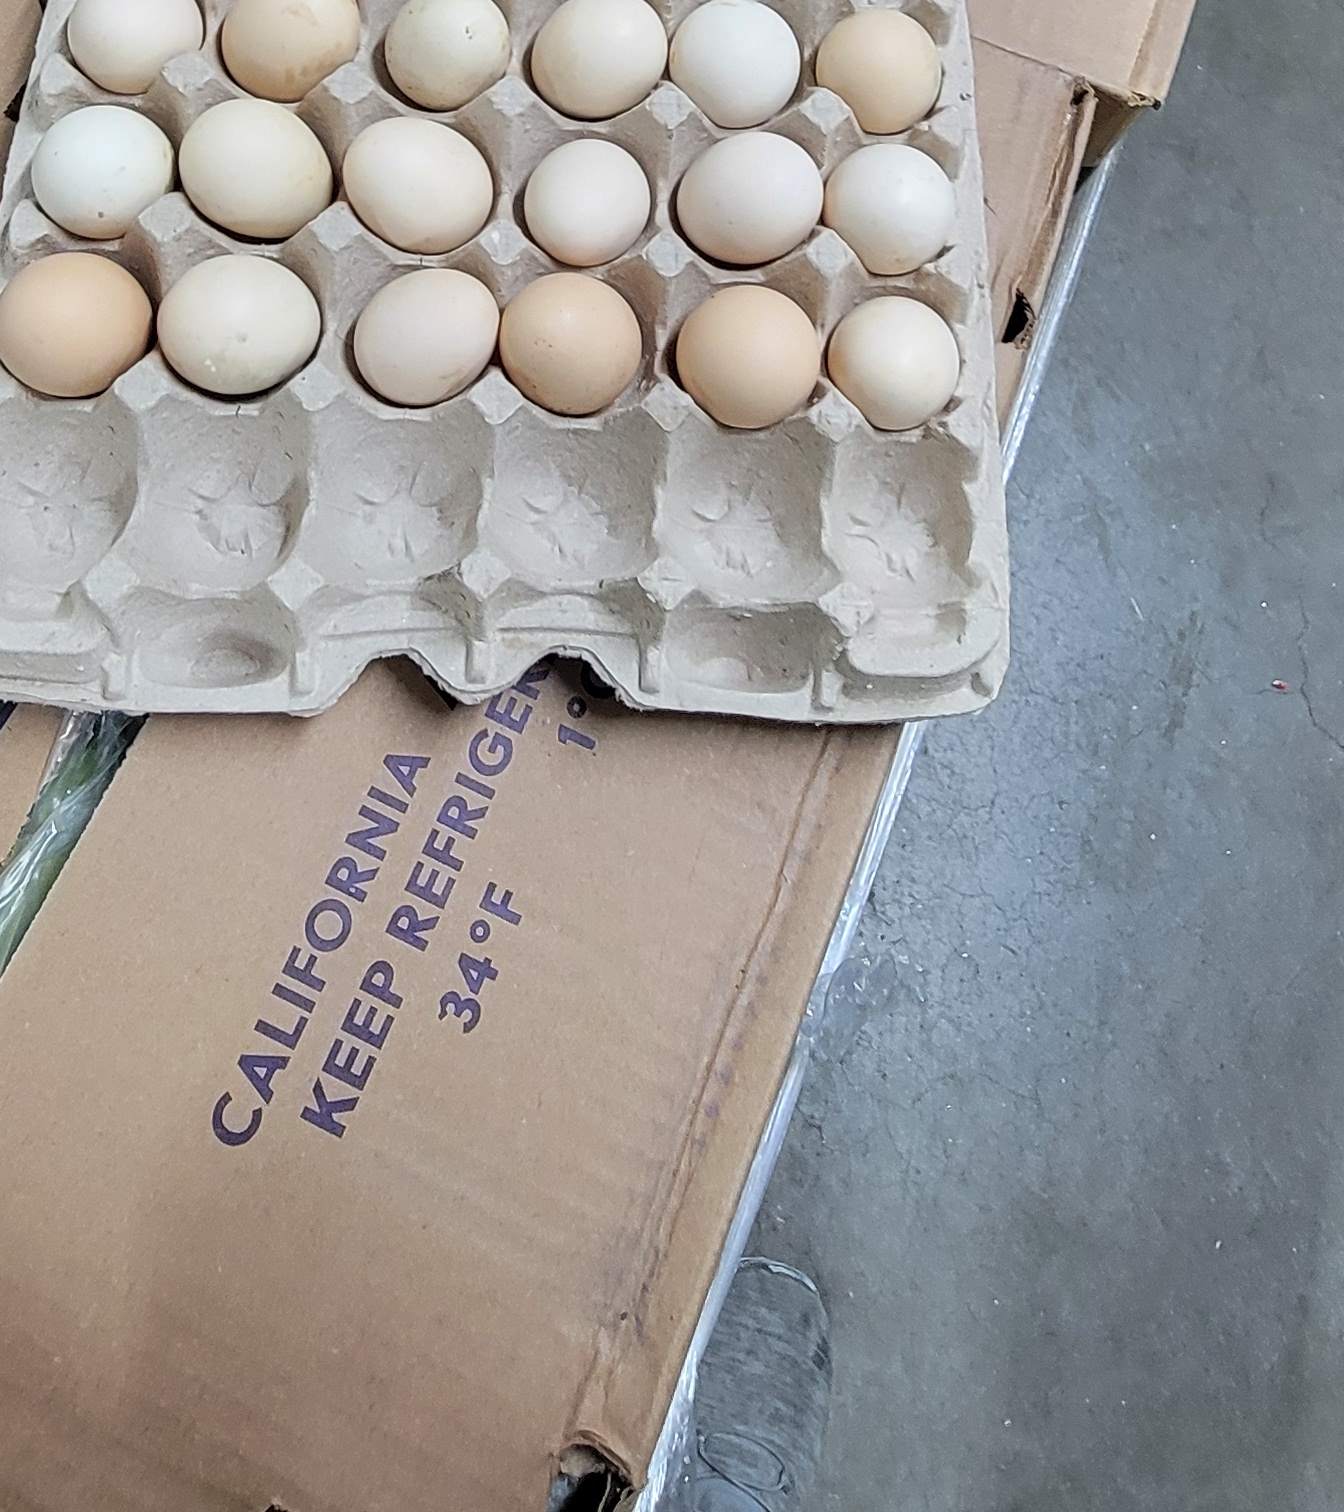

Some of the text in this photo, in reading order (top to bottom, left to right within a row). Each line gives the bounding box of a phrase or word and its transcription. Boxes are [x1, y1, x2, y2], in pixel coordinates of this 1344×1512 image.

[211, 752, 431, 1147] CALIFORNIA
[299, 653, 556, 1140] KEEP REFRIGER
[437, 880, 524, 1034] 34°F
